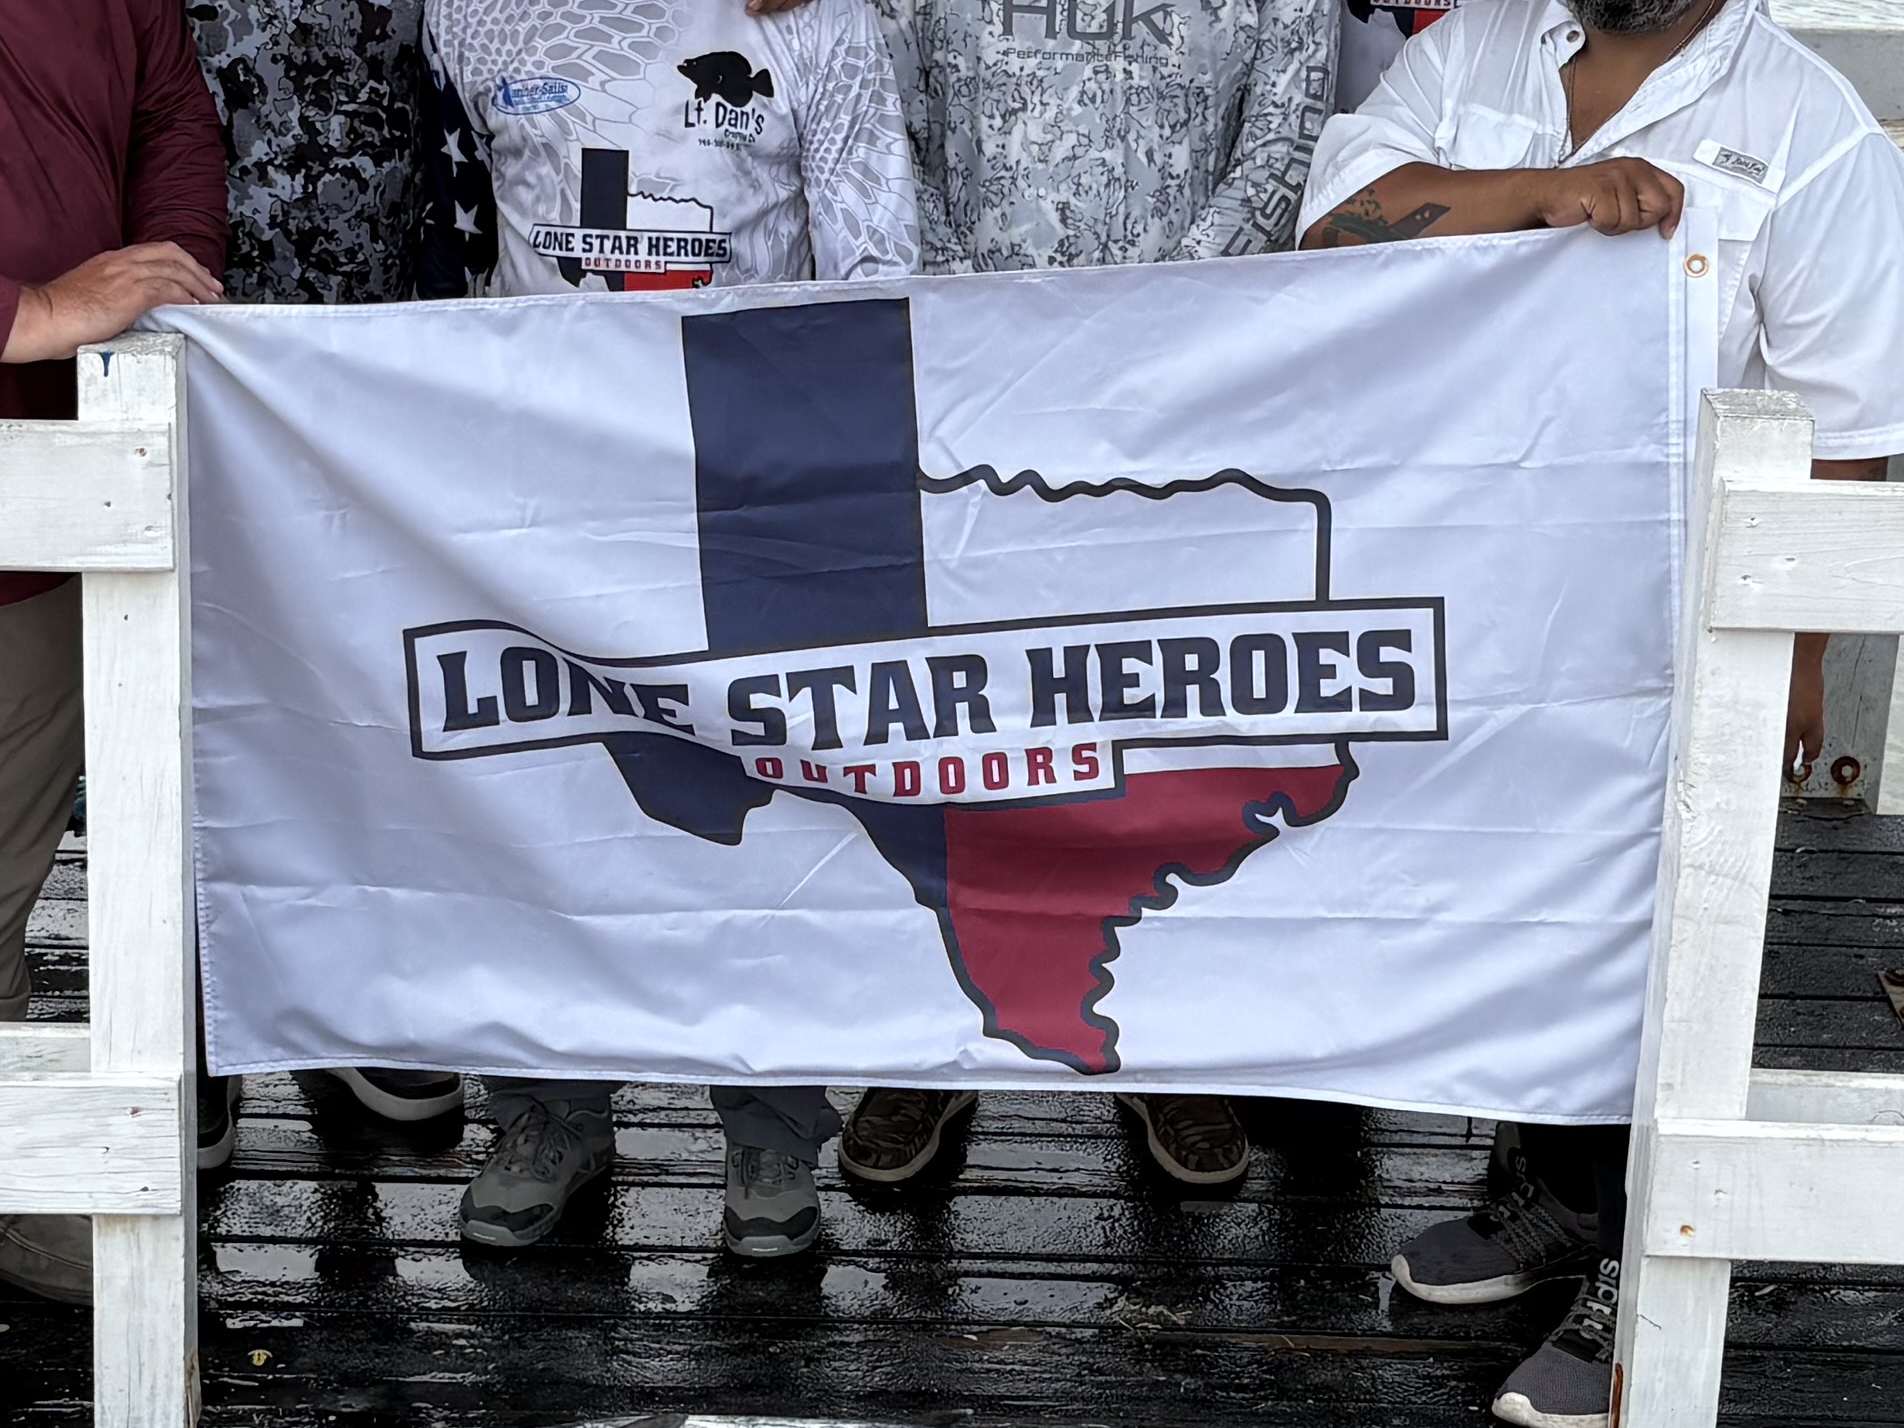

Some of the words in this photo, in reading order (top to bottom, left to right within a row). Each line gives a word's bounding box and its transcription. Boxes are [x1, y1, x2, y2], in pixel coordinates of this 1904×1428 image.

[684, 99, 708, 128] Lt.
[715, 101, 765, 135] Dan's
[532, 230, 575, 252] LONE
[581, 233, 640, 256] STAR
[647, 236, 728, 258] HEROES
[584, 257, 662, 270] OUTDOORS
[437, 645, 694, 735] LONE
[727, 652, 996, 752] STAR
[1028, 627, 1416, 728] HEROES
[754, 741, 1102, 798] OUTDOORS
